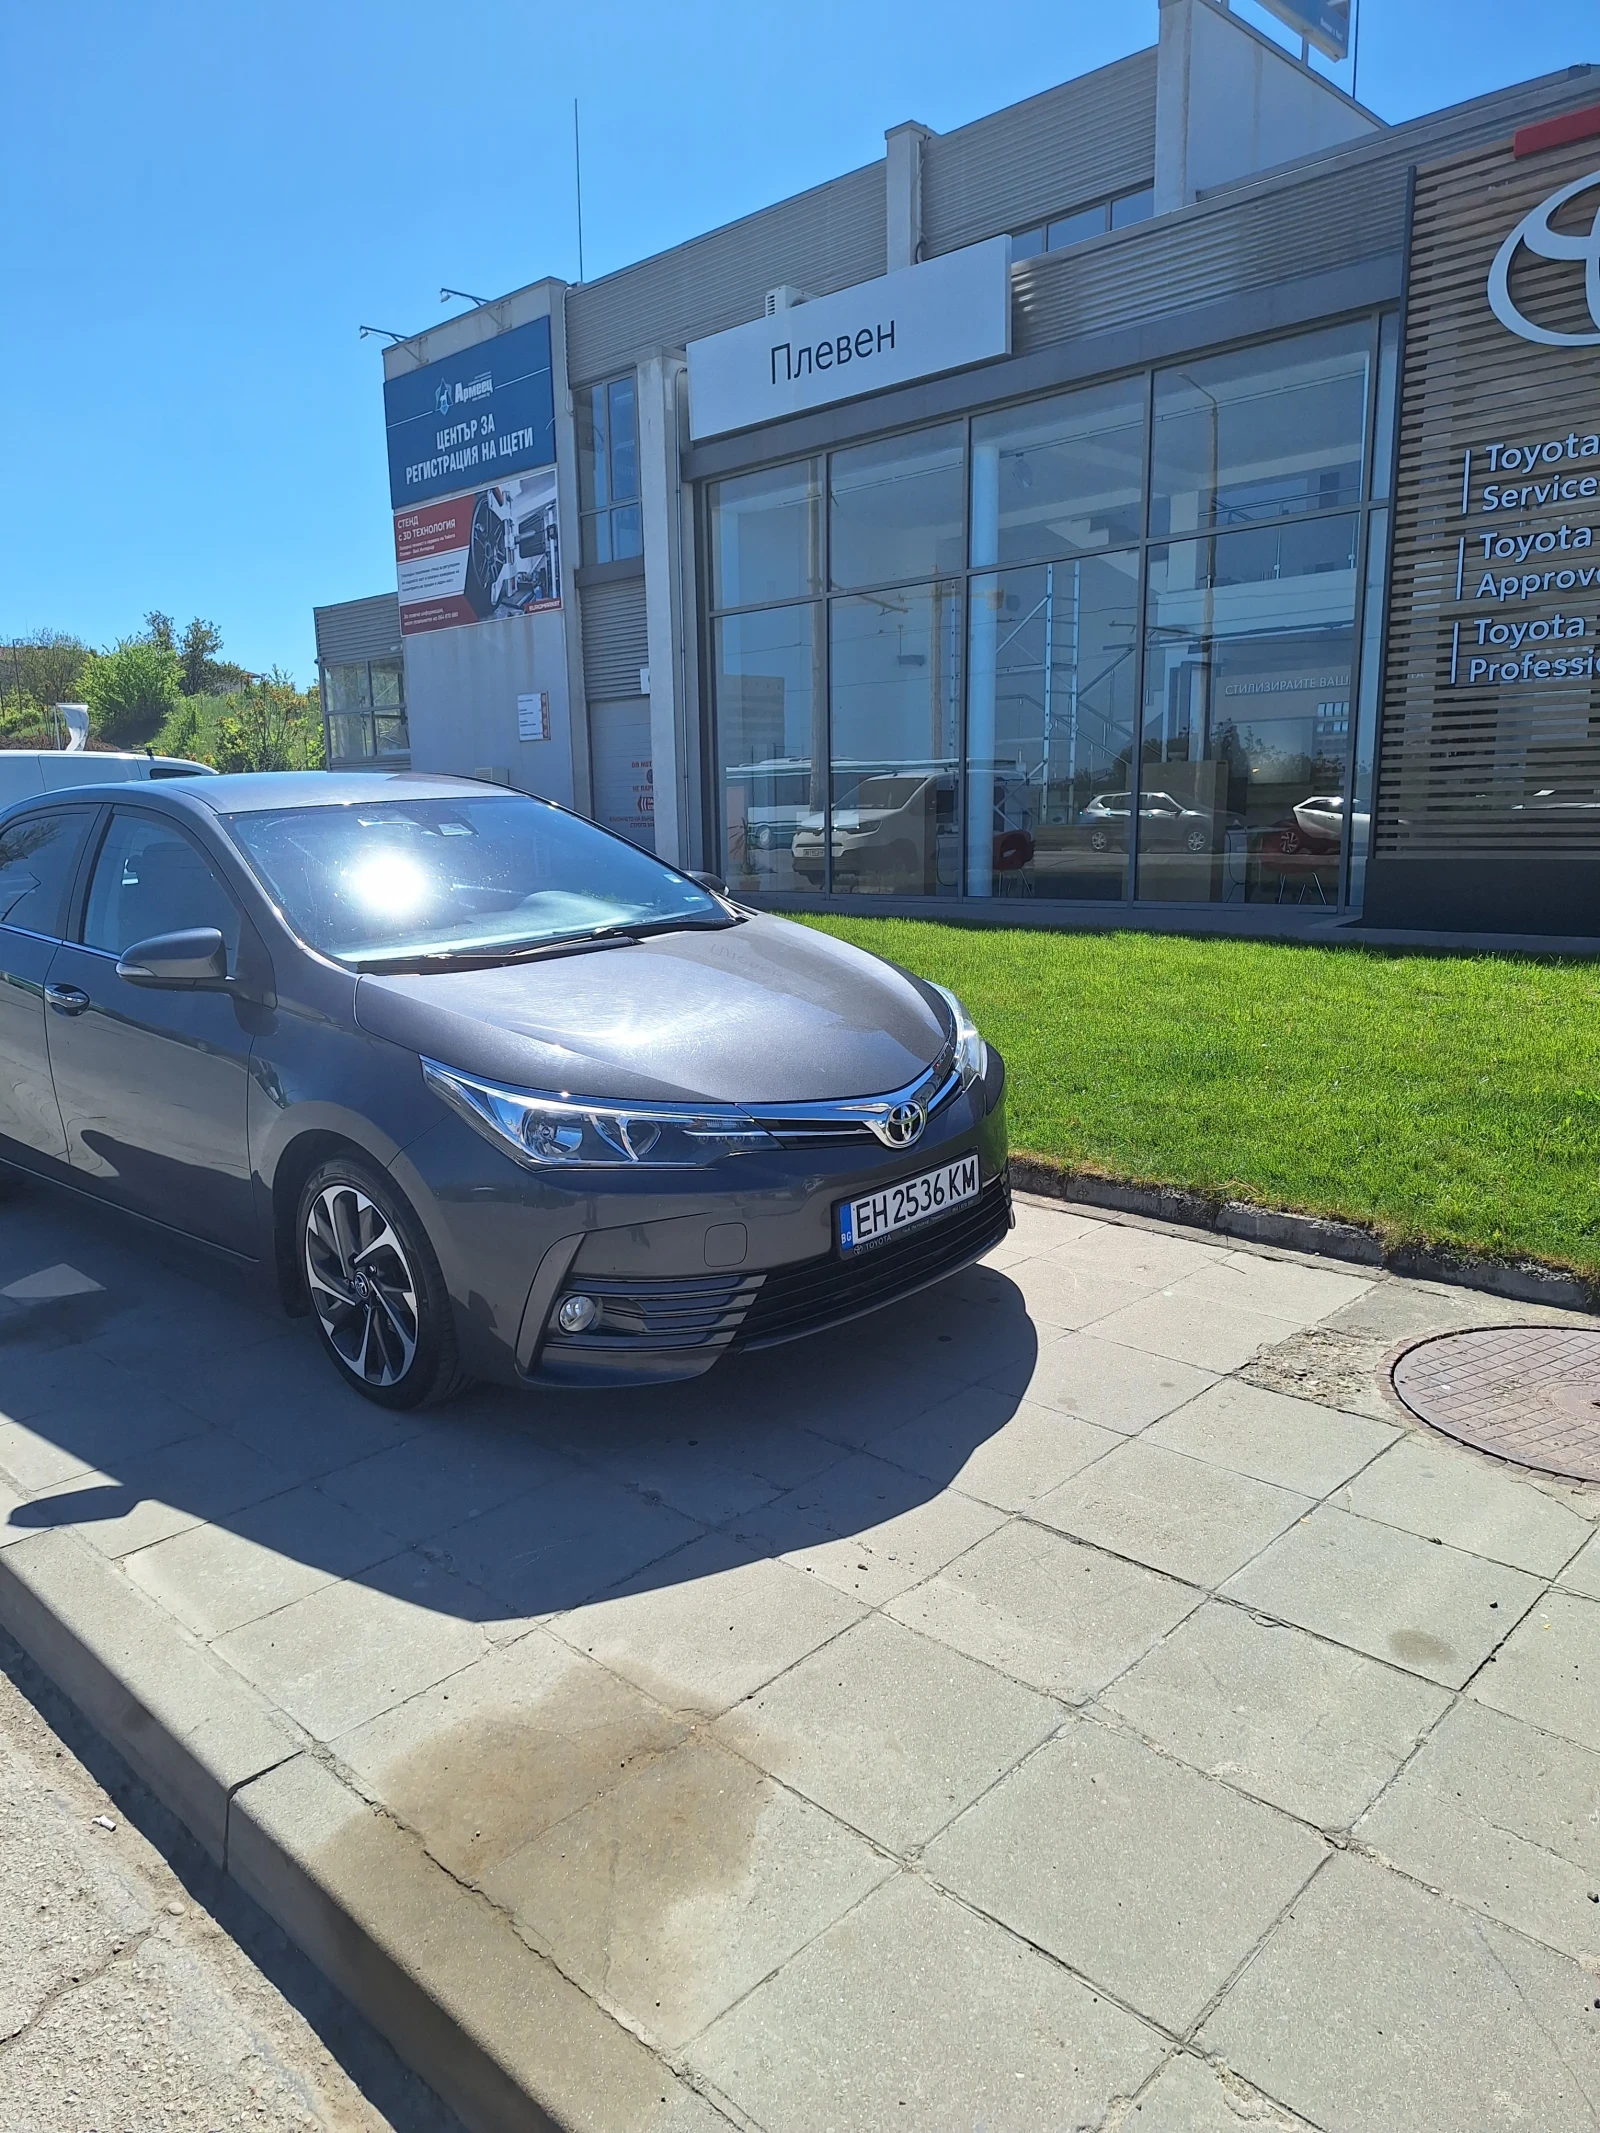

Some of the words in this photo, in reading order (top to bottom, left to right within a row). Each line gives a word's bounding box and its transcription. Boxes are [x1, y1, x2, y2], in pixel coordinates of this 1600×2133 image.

[771, 320, 895, 385] Плевен
[455, 379, 493, 404] Армеец
[436, 419, 478, 452] ЦЕНТЪР
[480, 413, 495, 436] ЗА
[405, 445, 479, 485] РЕГИСТРАЦИЯ
[481, 439, 497, 462] НА
[499, 427, 534, 458] ЩЕТИ
[1485, 432, 1600, 474] Toyota
[1482, 474, 1597, 511] Service
[397, 515, 419, 529] СТЕНД
[412, 518, 456, 538] ТЕХНОЛОГИЯ
[1479, 524, 1592, 563] Toyota
[1476, 567, 1600, 602] Approv
[1473, 613, 1586, 649] Toyota
[1469, 648, 1600, 683] Professi
[1225, 676, 1316, 696] СТИЛИЗИРАЙТЕ
[1319, 674, 1350, 688] ВАШ
[841, 1231, 852, 1244] BG
[866, 1234, 892, 1250] TOYOTA
